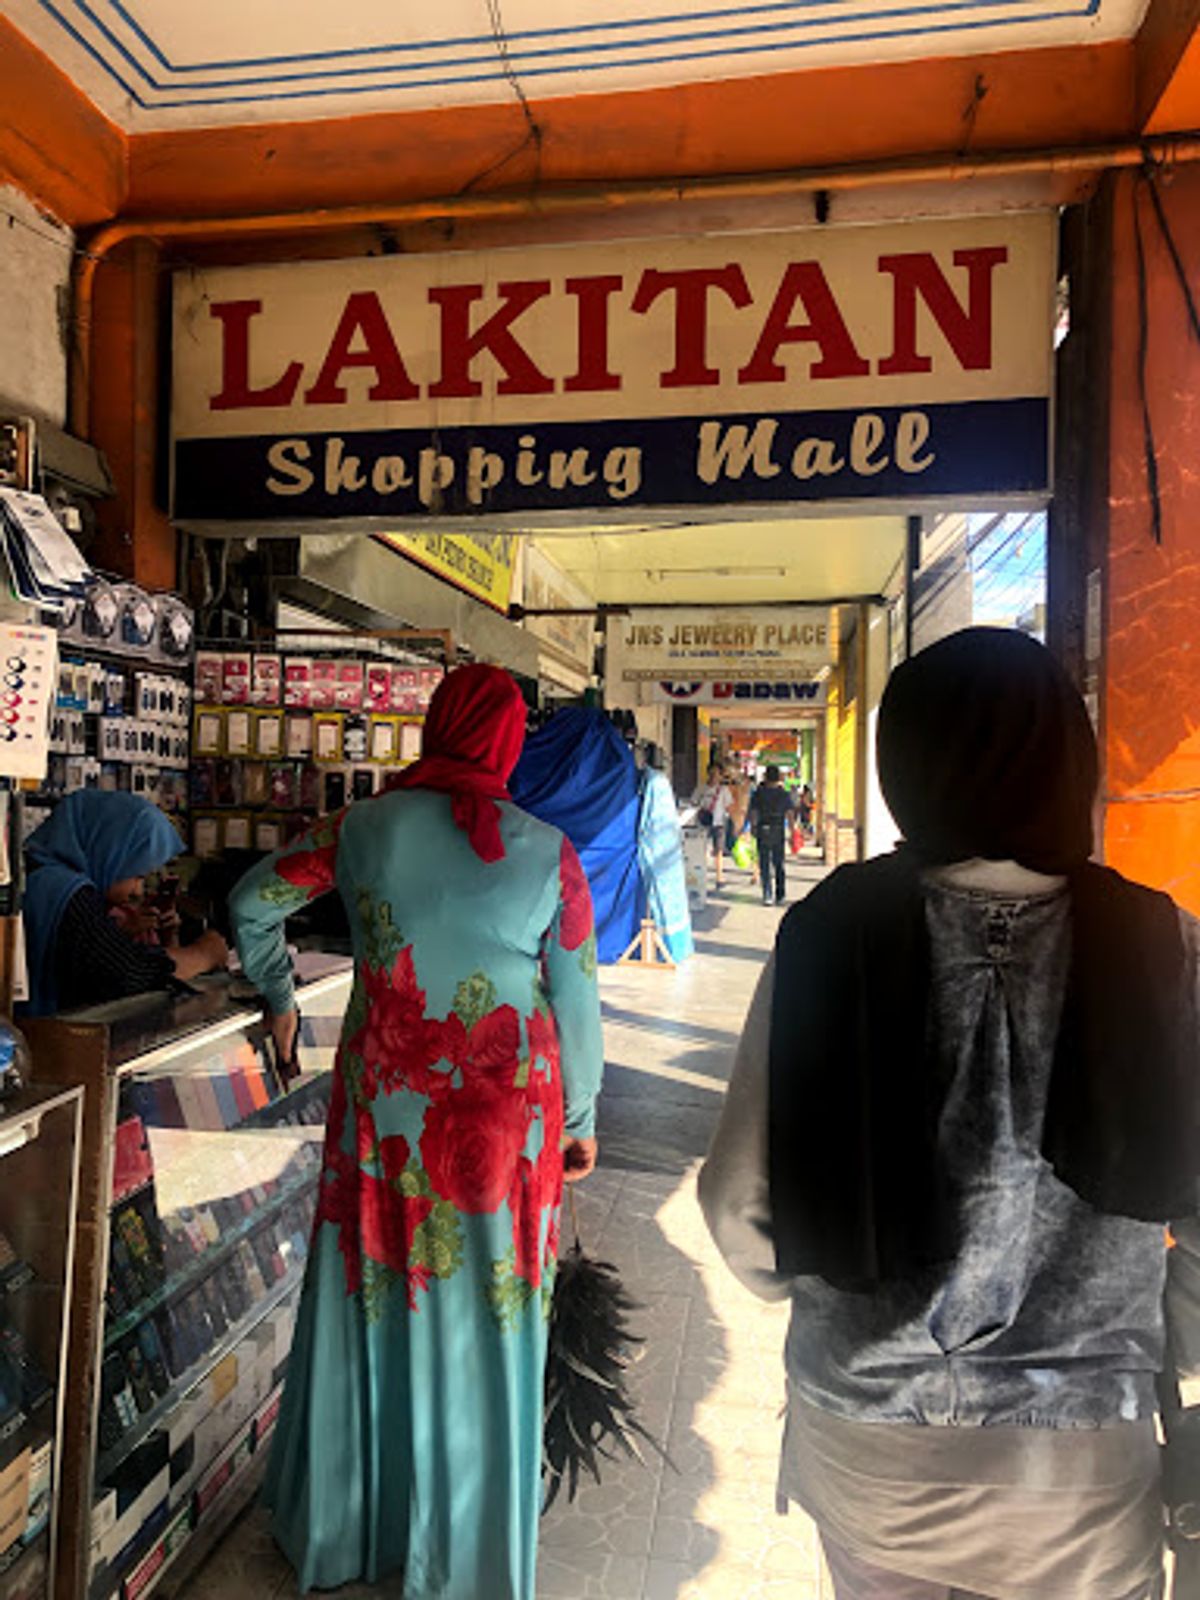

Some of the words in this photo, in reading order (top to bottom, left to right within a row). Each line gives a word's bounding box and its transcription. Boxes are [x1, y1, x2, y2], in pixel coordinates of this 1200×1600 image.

[209, 246, 1010, 411] LAKITAN
[265, 436, 643, 505] Shopping
[697, 412, 936, 484] Mall
[625, 624, 664, 646] JNS
[764, 623, 827, 645] PLACE
